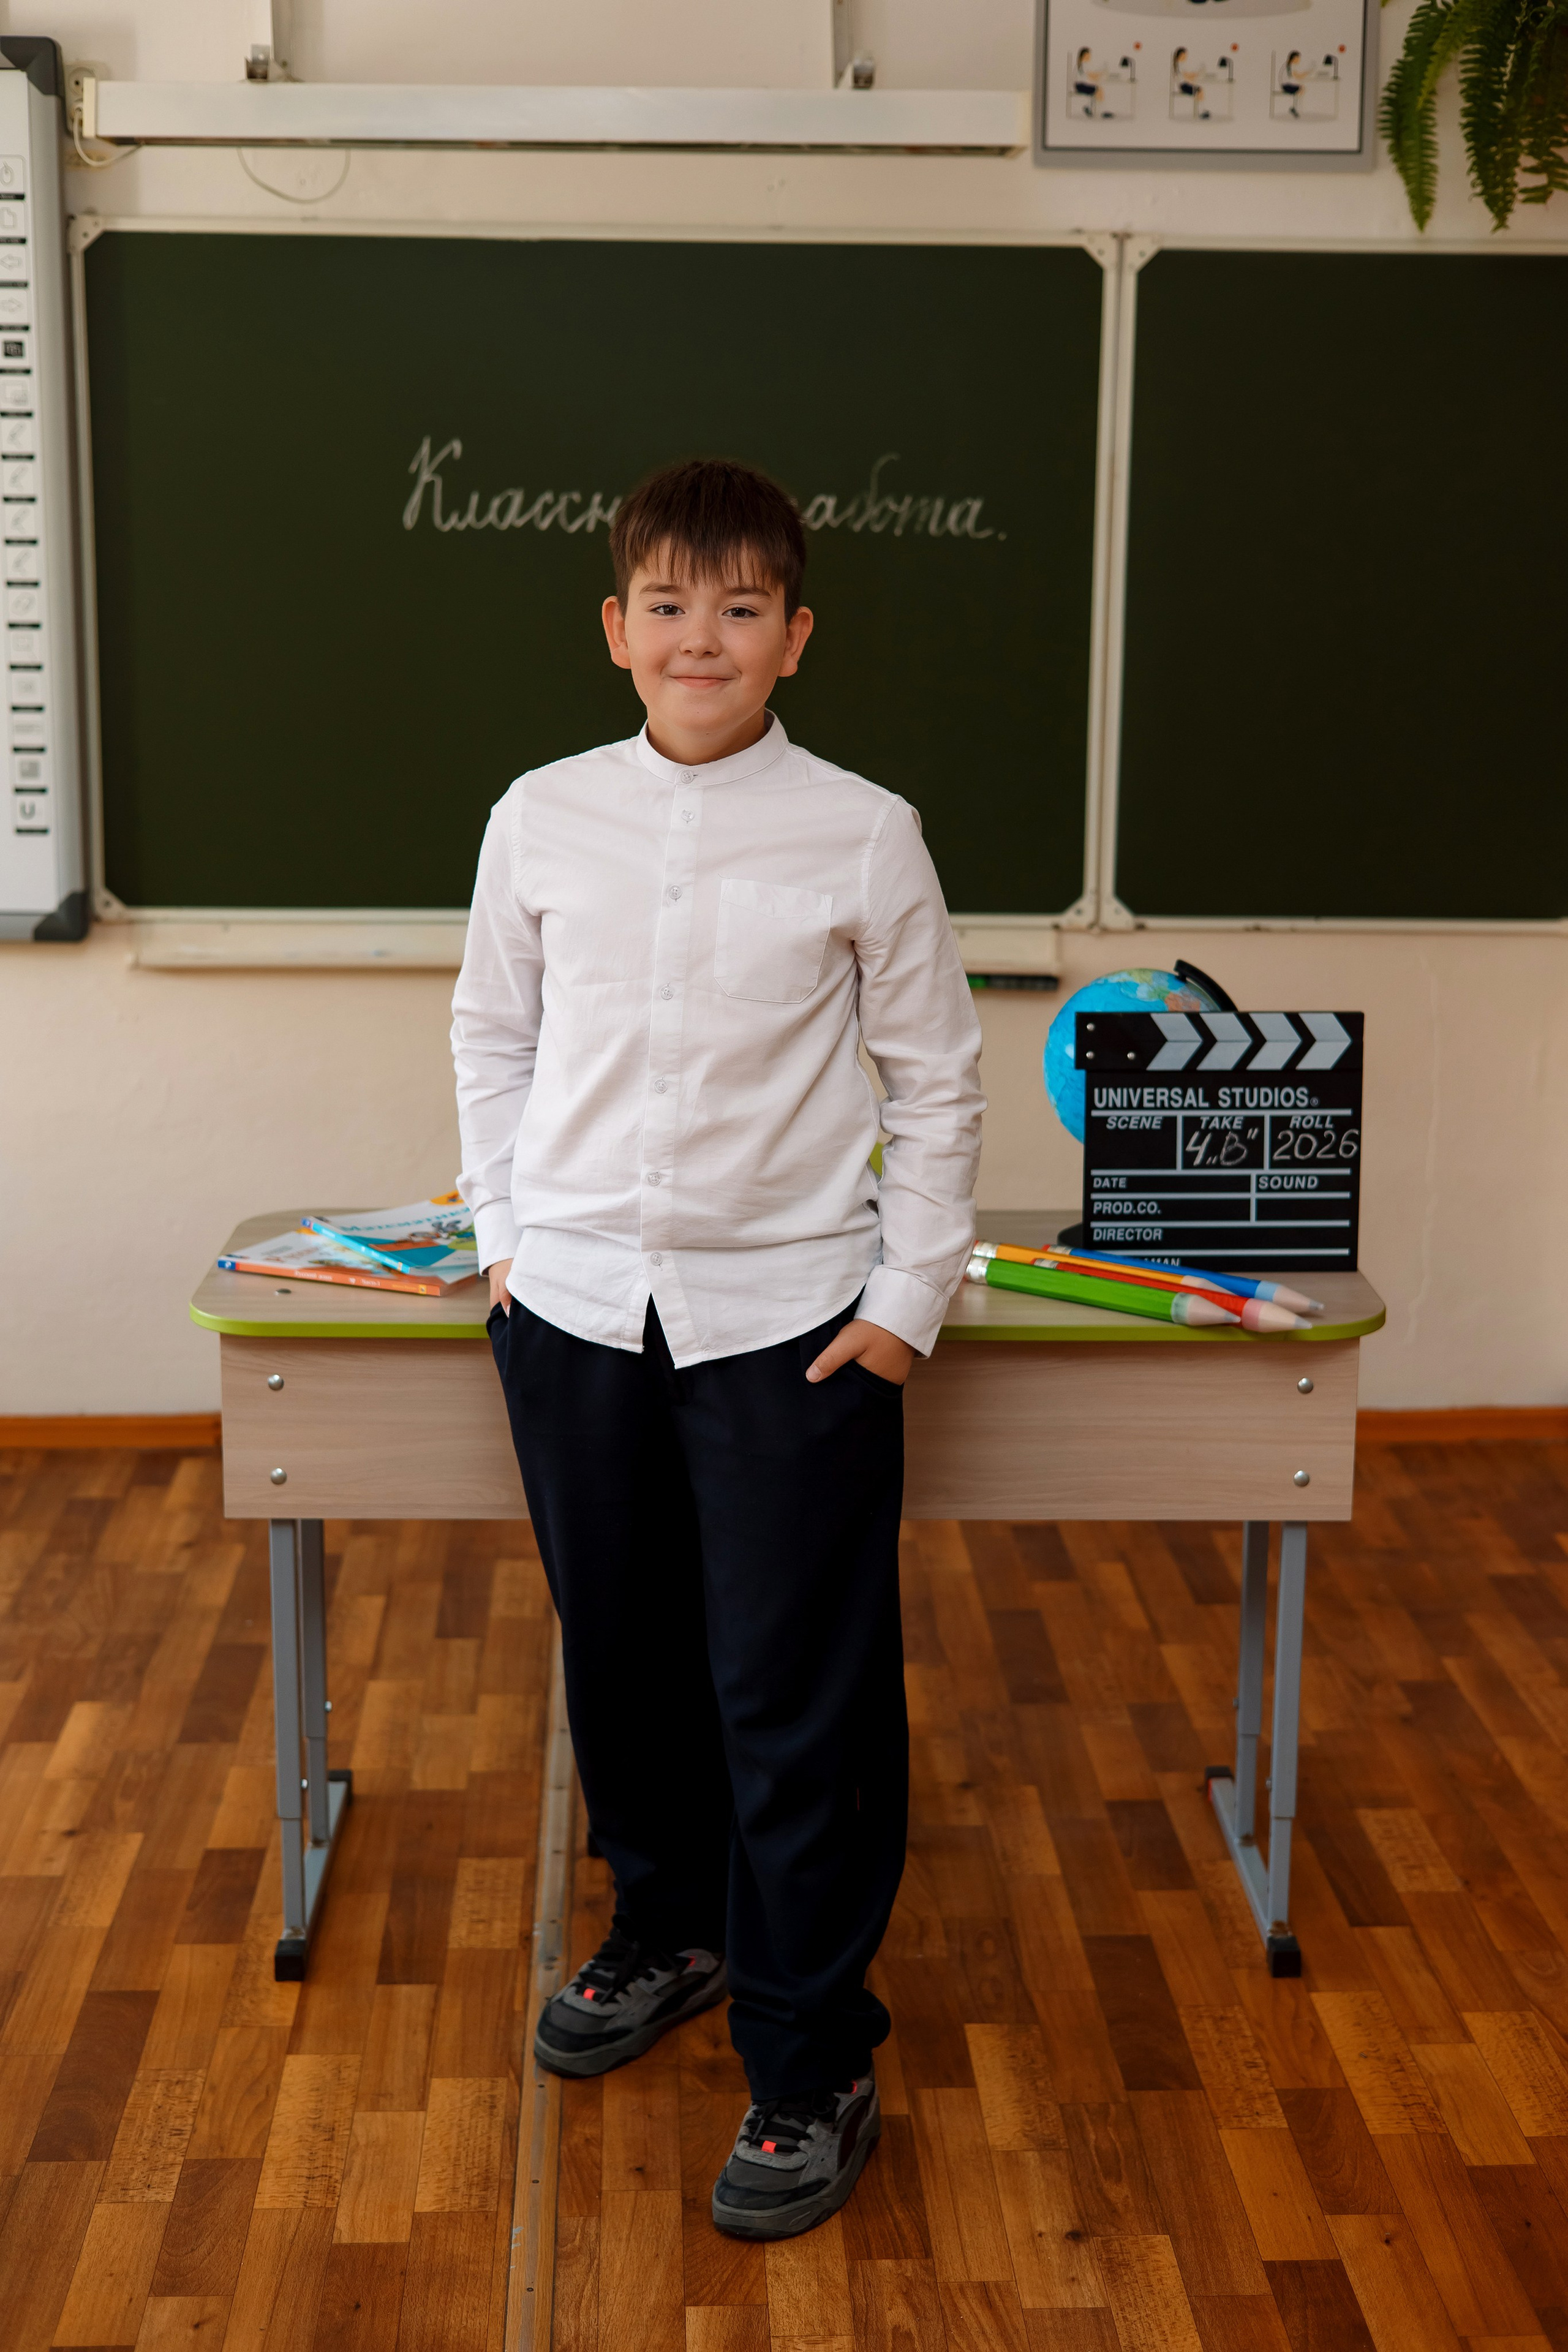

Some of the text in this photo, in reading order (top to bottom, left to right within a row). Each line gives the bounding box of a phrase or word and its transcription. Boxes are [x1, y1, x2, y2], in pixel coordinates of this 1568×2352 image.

[402, 435, 1008, 541] Классн абота.
[1093, 1087, 1209, 1108] UNIVERSAL
[1106, 1116, 1163, 1129] SCENE
[1200, 1115, 1244, 1129] TAKE
[1289, 1115, 1335, 1129] ROLL
[1272, 1129, 1359, 1161] 2026
[1093, 1177, 1128, 1189] DATE
[1258, 1175, 1319, 1189] SOUND
[1093, 1201, 1161, 1215] PROD.CO.
[1093, 1227, 1163, 1242] DIRECTOR
